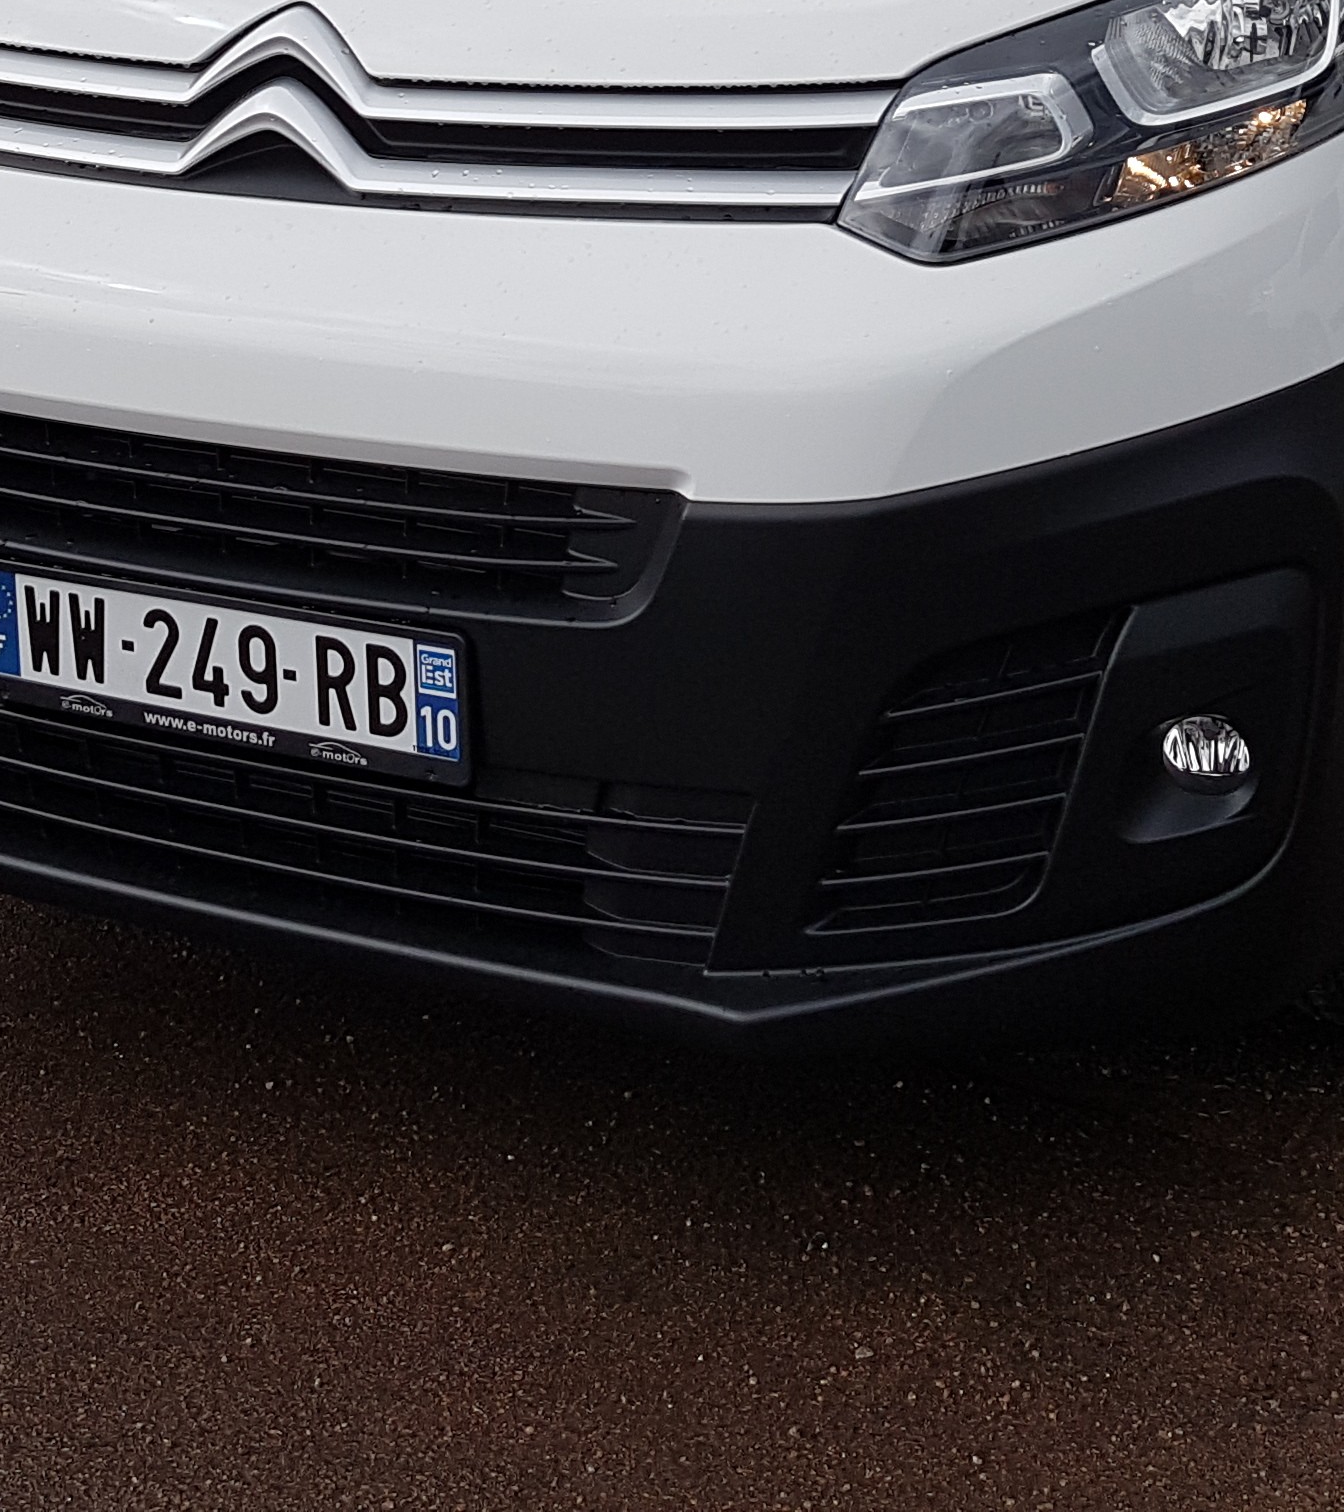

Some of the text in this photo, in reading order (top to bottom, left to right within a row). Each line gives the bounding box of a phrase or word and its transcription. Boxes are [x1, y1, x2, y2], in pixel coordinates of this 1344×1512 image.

[24, 584, 408, 738] WW-249-RB
[421, 654, 452, 668] Grand
[421, 665, 453, 687] Est
[143, 711, 276, 747] www.e-motors.fr
[420, 706, 457, 751] 10
